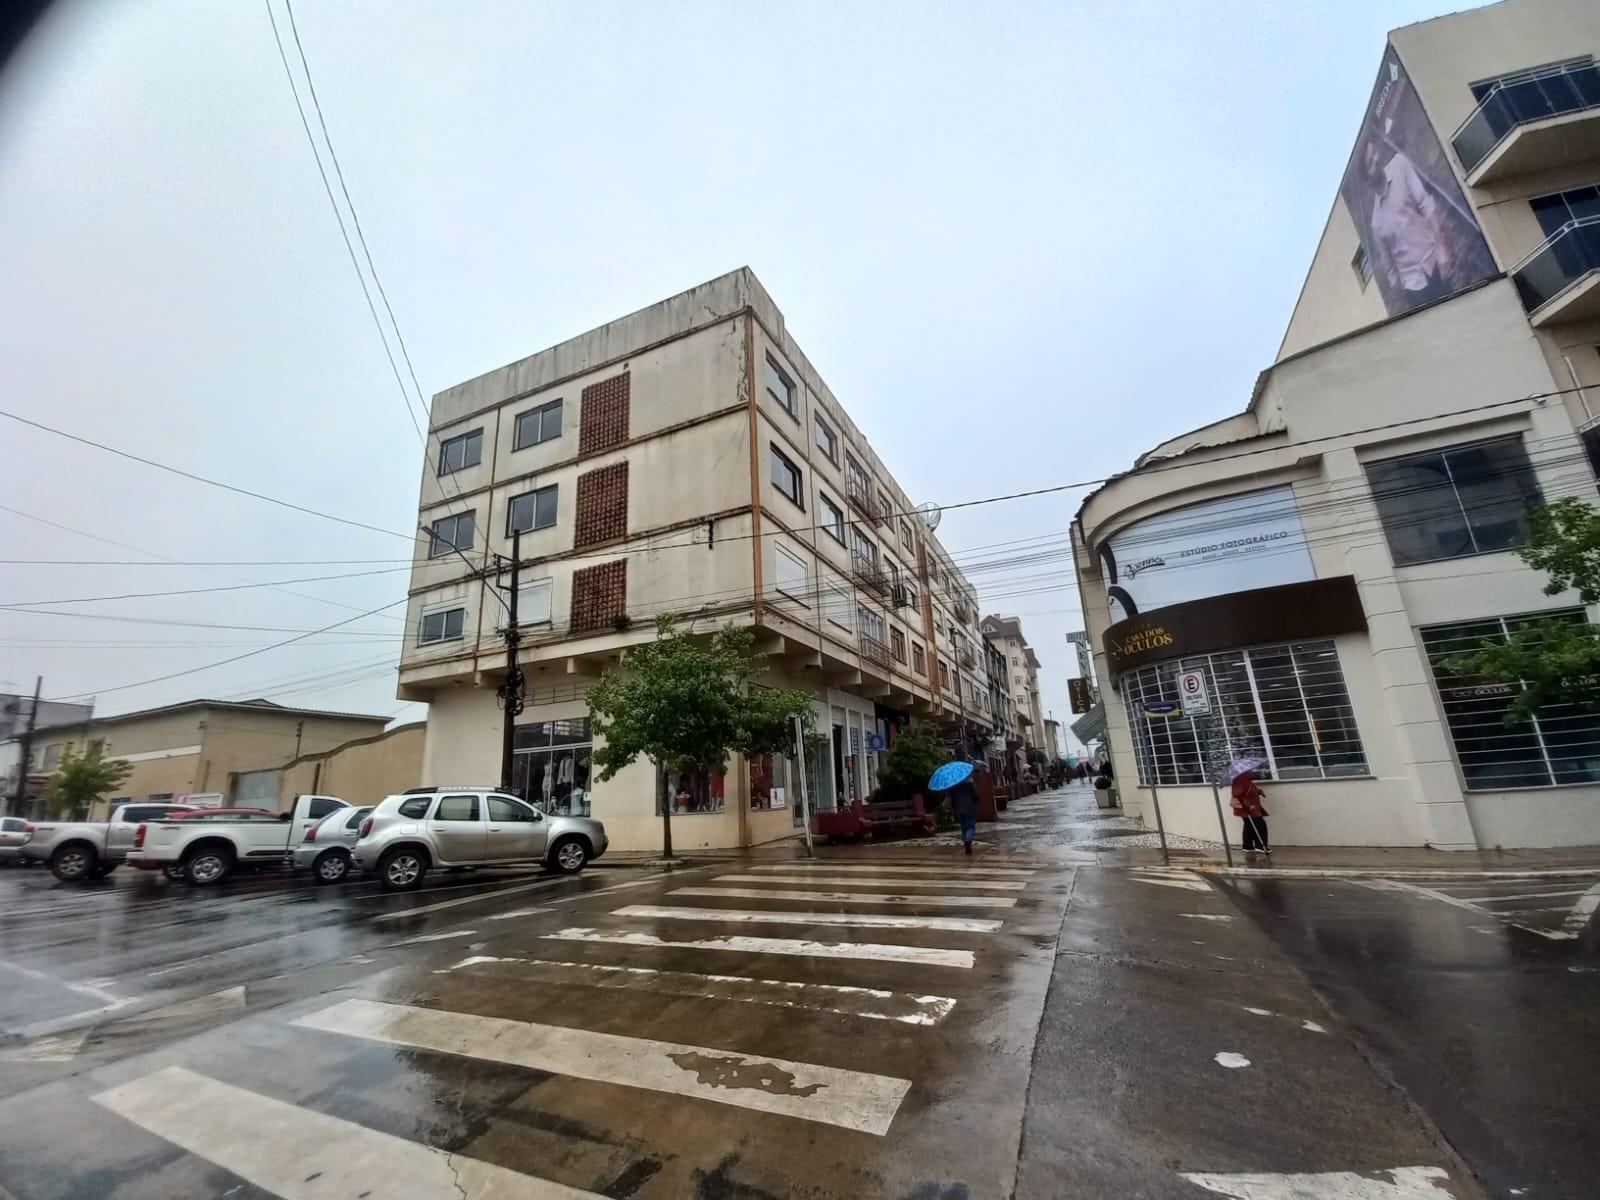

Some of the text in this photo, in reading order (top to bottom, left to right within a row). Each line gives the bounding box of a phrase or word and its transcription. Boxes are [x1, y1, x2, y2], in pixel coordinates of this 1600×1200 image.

[1180, 531, 1288, 558] ESTÚDIO FOTOGRÁFICO
[1187, 678, 1195, 690] E
